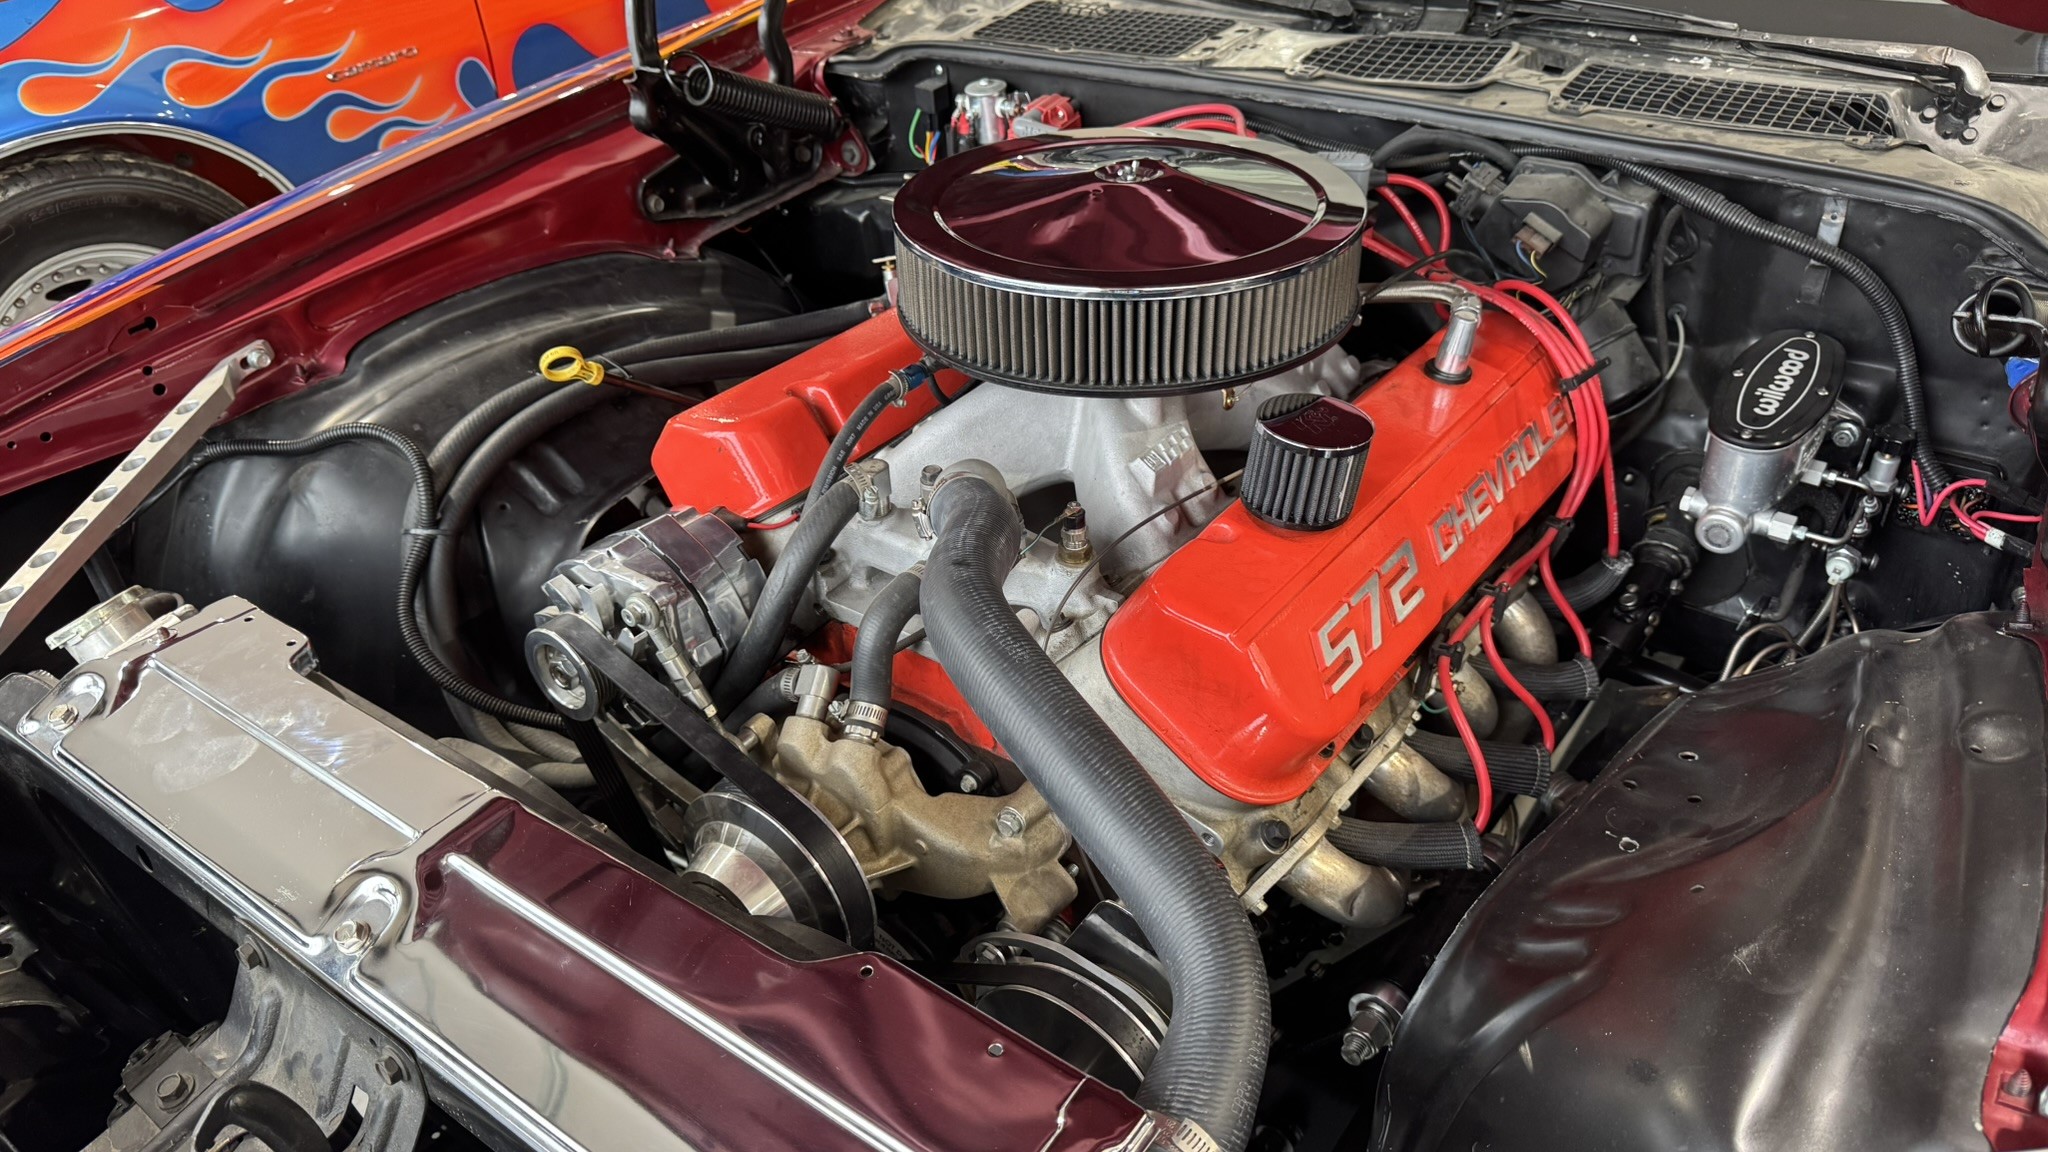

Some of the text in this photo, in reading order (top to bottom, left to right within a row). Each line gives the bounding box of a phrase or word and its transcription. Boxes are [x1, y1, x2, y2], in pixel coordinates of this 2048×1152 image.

[856, 416, 869, 430] MADE
[872, 401, 882, 410] USA
[1752, 346, 1811, 416] wilwood
[1314, 538, 1427, 698] 572
